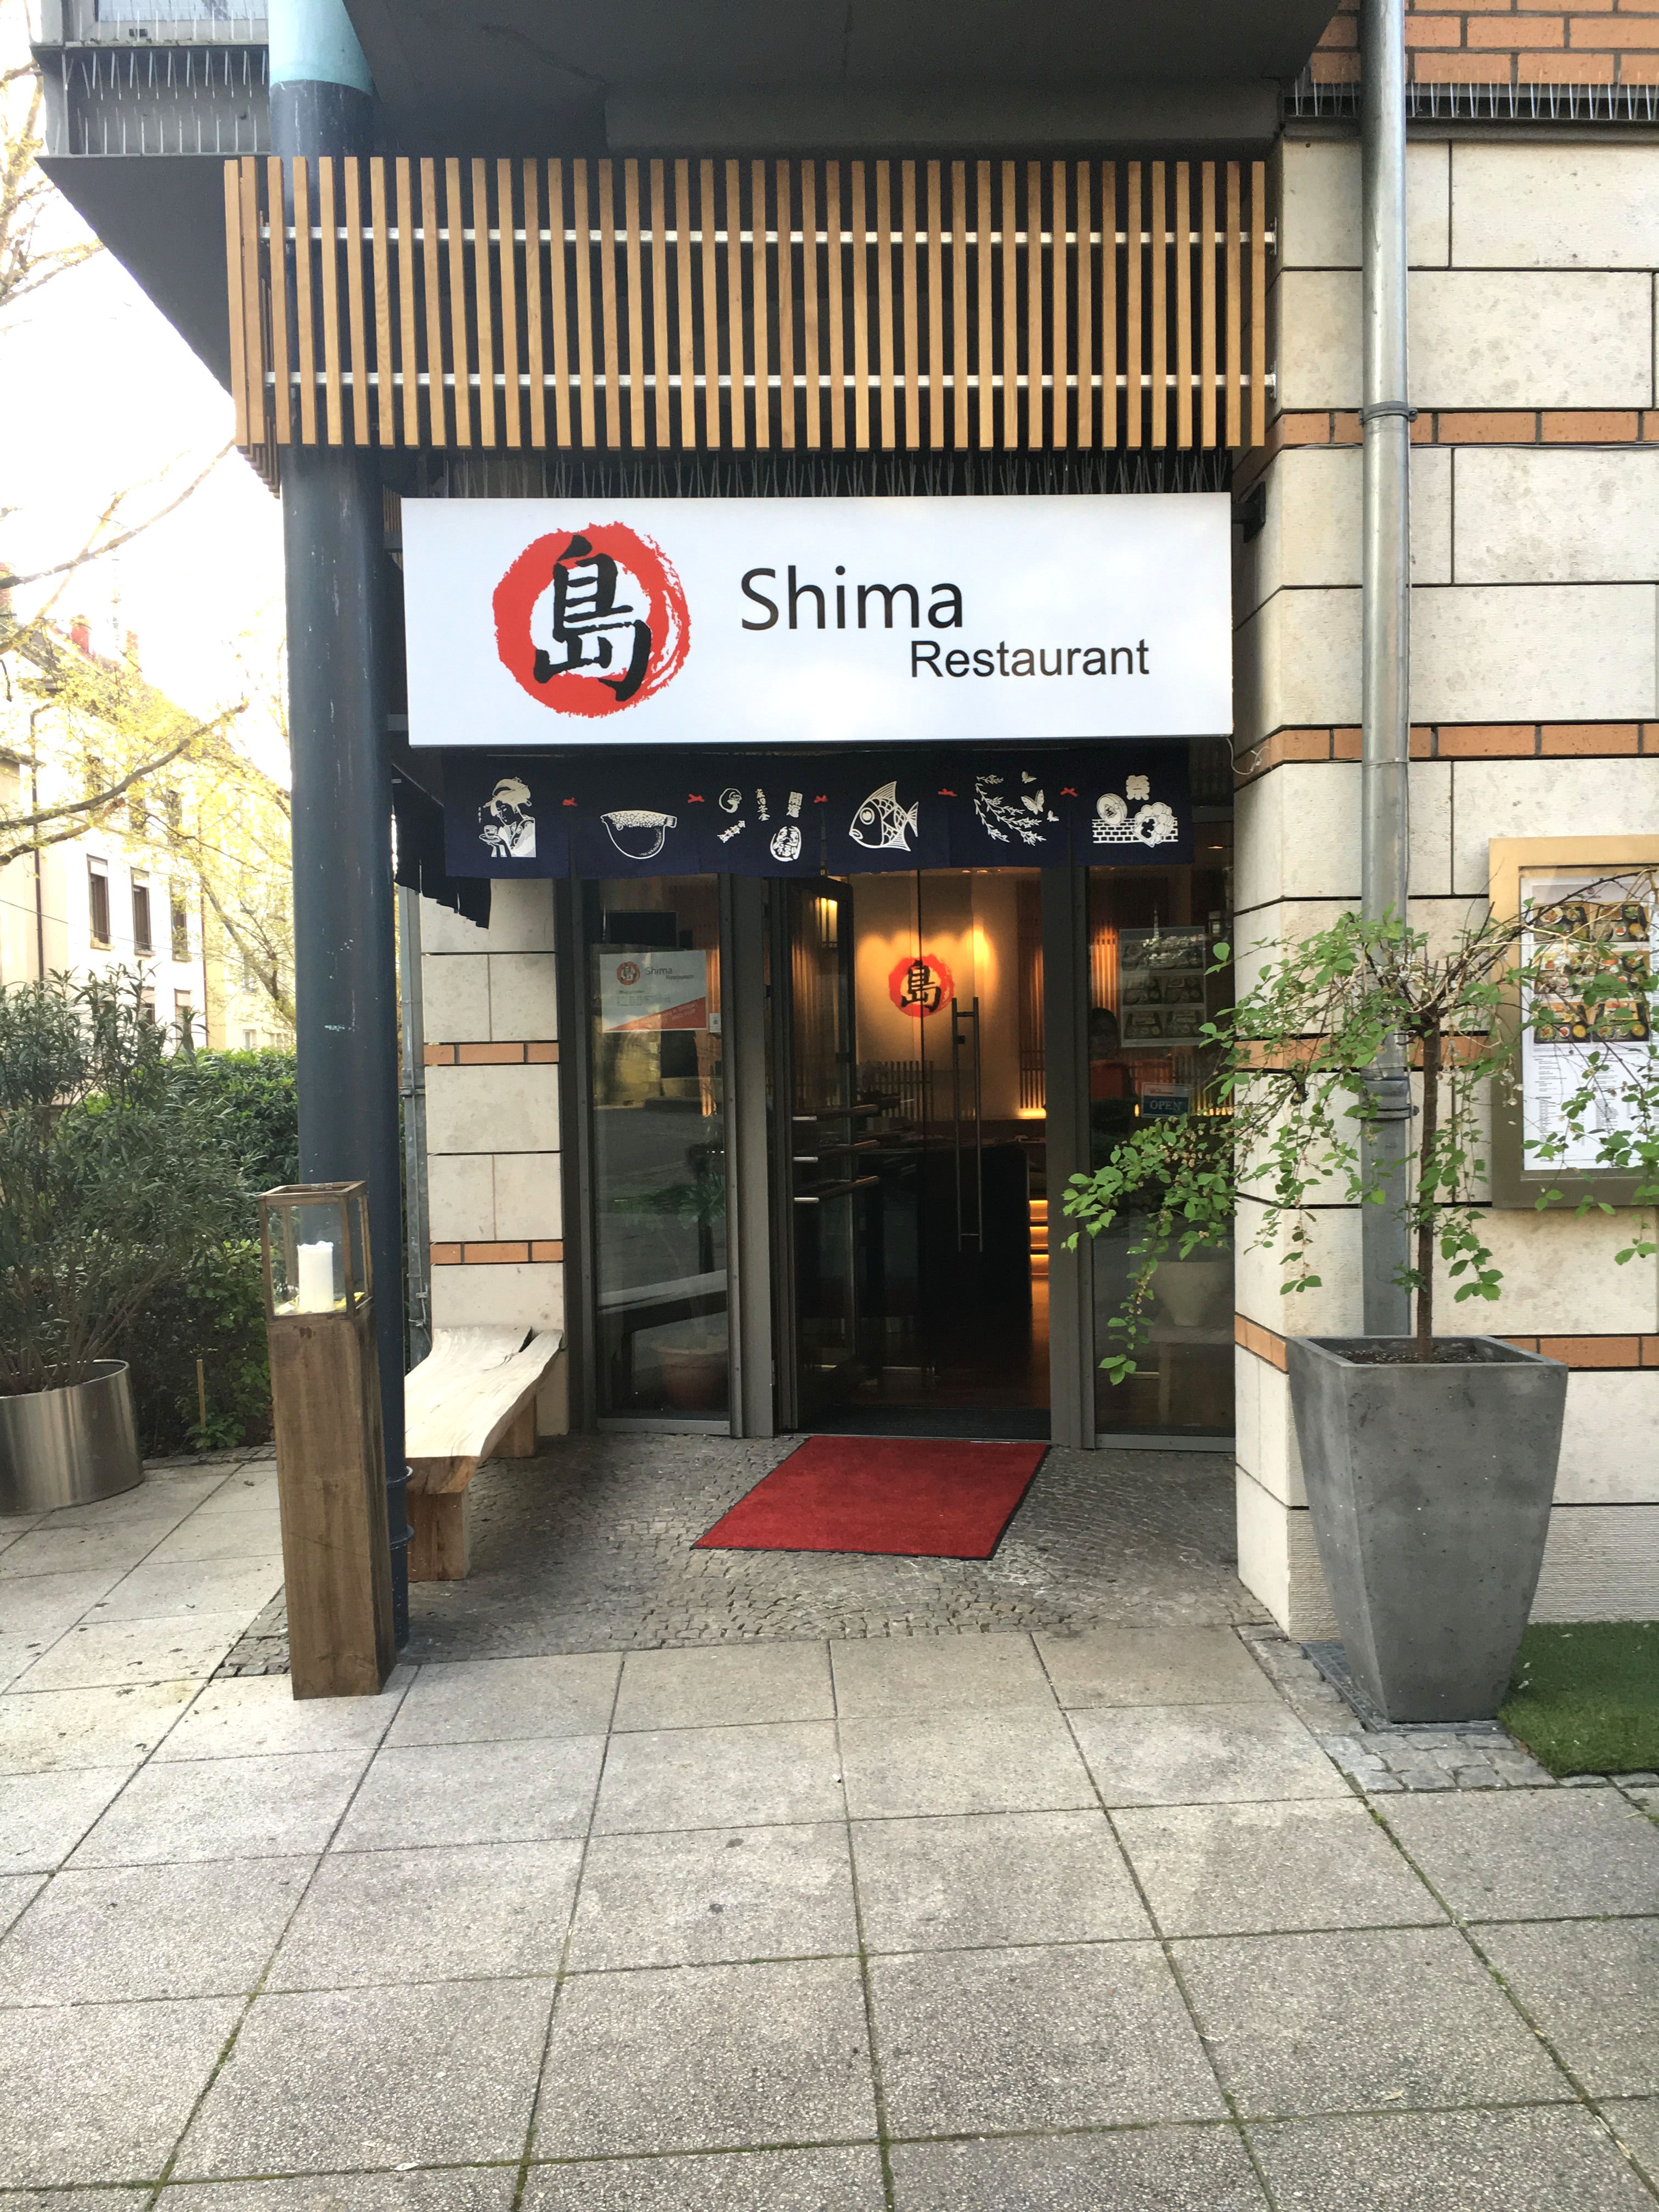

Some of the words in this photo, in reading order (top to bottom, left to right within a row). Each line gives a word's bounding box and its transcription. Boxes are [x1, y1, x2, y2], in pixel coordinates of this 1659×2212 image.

[533, 535, 652, 701] 島
[741, 565, 962, 630] Shima
[911, 639, 1149, 678] Restaurant
[645, 967, 673, 975] Shima
[901, 959, 941, 1013] 島
[1149, 1100, 1183, 1110] OPEN
